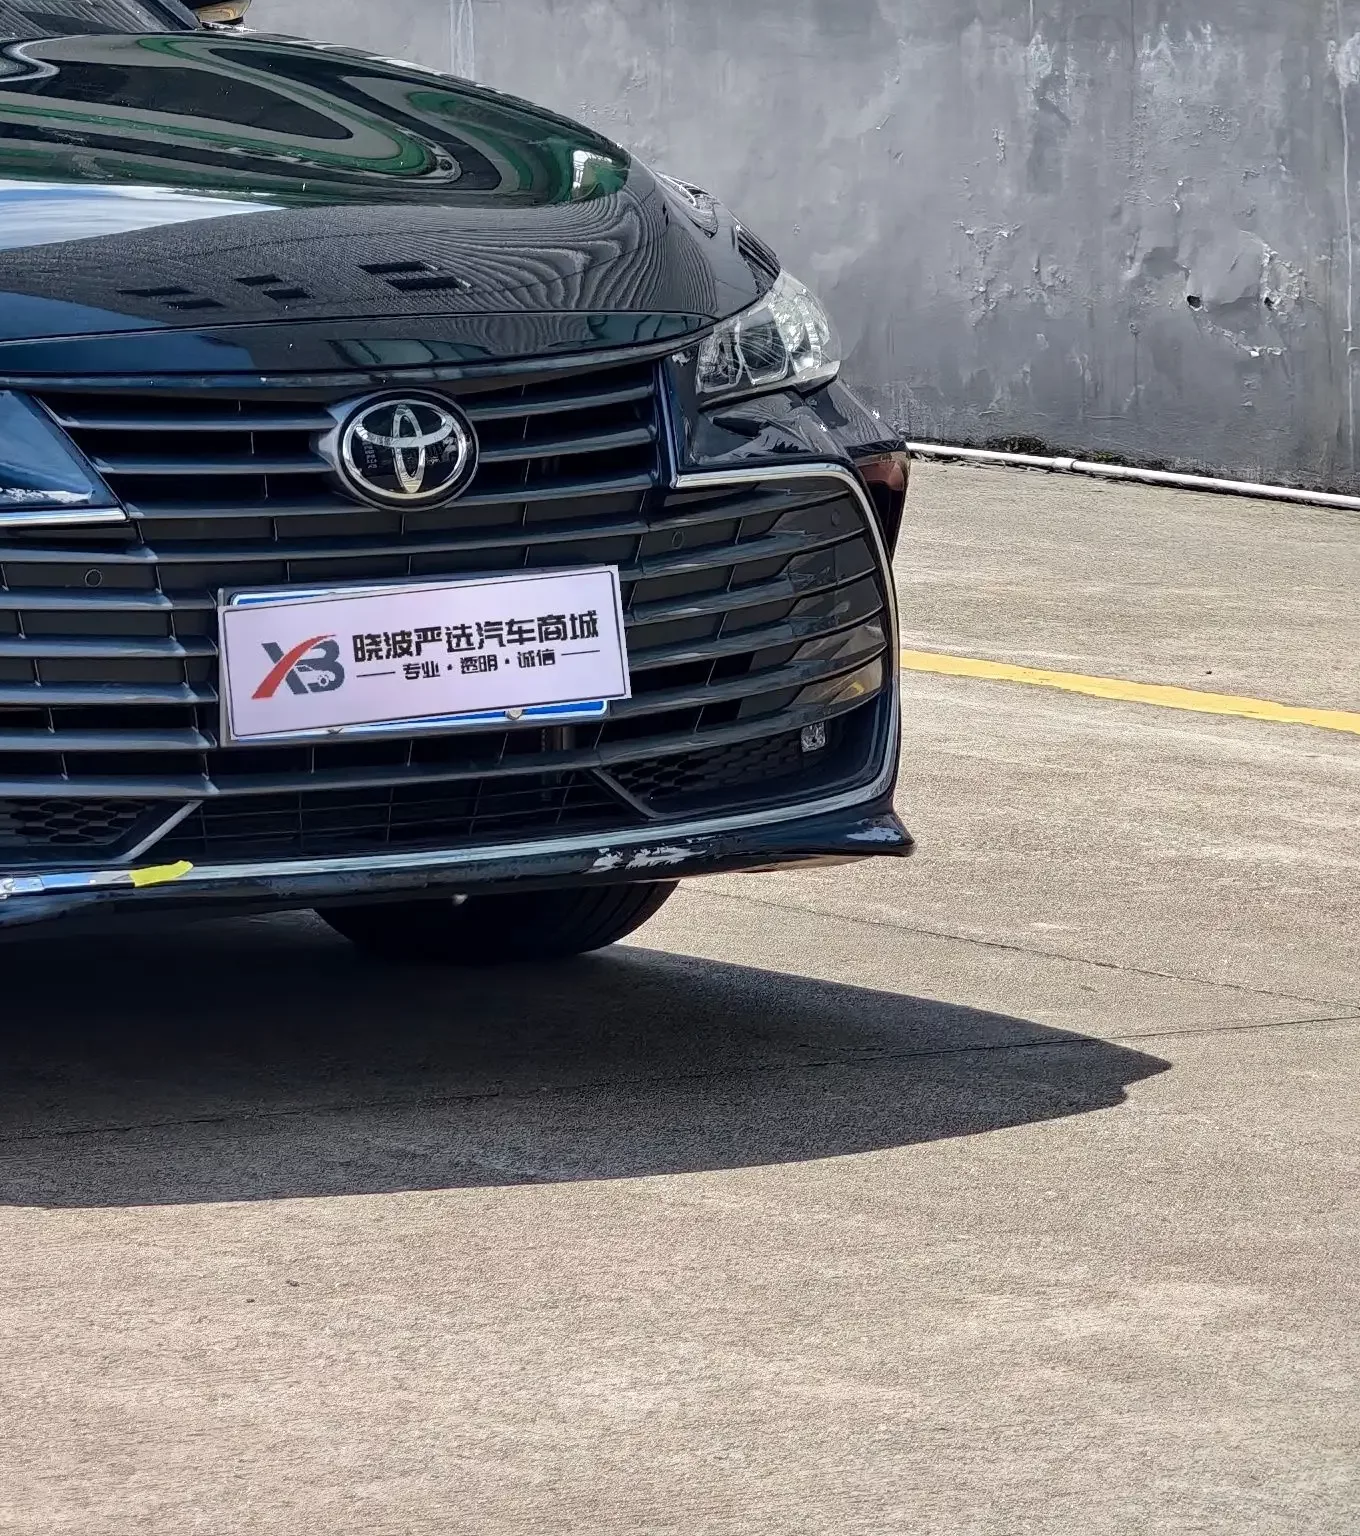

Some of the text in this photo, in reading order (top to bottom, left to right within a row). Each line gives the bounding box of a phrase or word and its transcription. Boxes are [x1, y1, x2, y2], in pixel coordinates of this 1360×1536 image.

[352, 610, 598, 663] 晓波严选汽车商城
